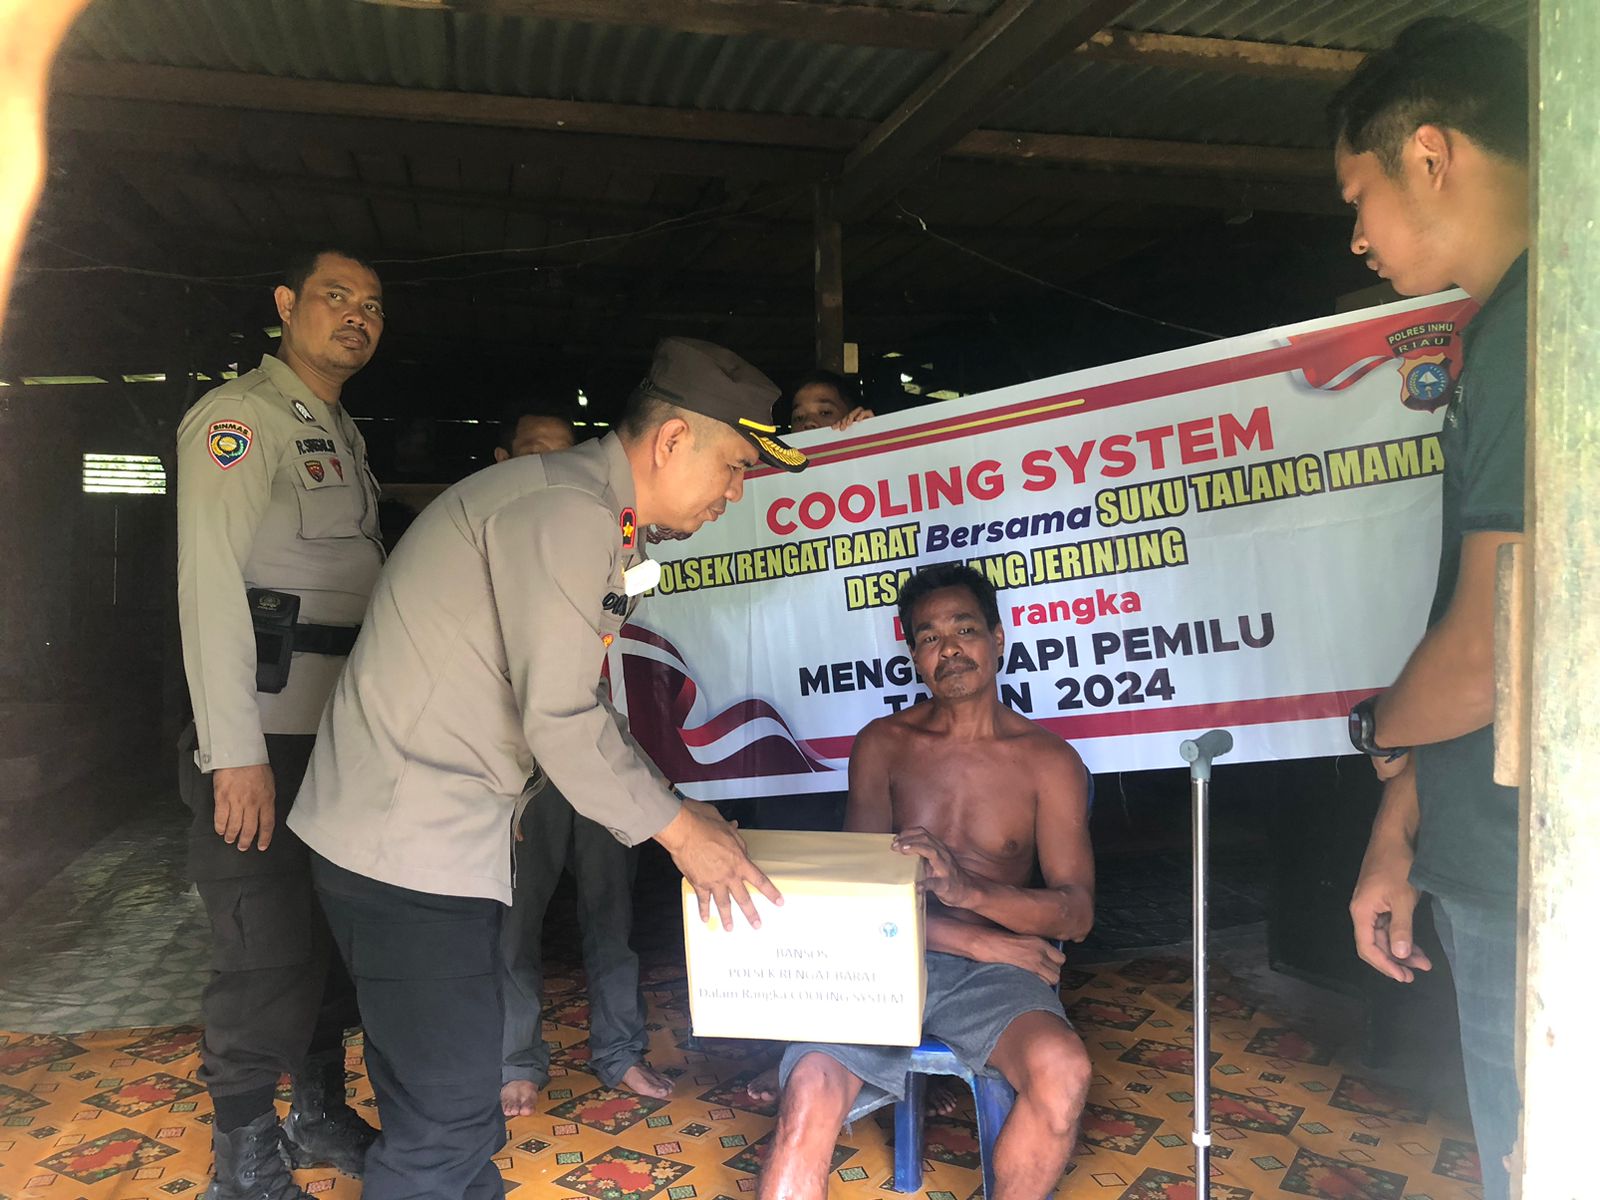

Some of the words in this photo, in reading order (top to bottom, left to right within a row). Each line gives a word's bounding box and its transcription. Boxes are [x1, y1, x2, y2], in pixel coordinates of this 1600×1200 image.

[1388, 325, 1426, 344] POLRES
[1428, 323, 1453, 332] INHU
[1398, 338, 1444, 353] RIAU
[213, 423, 249, 435] BINMAS
[766, 459, 1004, 535] COOLING
[1021, 406, 1274, 492] SYSTEM
[643, 554, 738, 598] OLSEK
[733, 538, 834, 584] RENGAT
[833, 522, 920, 571] BARAT
[925, 505, 1092, 553] Bersama
[1096, 475, 1190, 527] SUKU
[1189, 452, 1324, 513] TALANG
[1029, 526, 1189, 588] JERINJING
[1011, 588, 1142, 627] rangka
[799, 634, 1080, 697] MENGAPI
[1092, 612, 1275, 667] PEMILU
[1056, 667, 1176, 711] 2024
[776, 948, 828, 960] BANSOS
[728, 967, 775, 979] POLSEK
[779, 968, 830, 981] RENGAT
[835, 970, 878, 983] BARAT
[698, 987, 738, 999] Dalam
[742, 988, 790, 1002] Rangka
[790, 990, 849, 1002] COOLING
[852, 991, 904, 1004] SYSTEM
